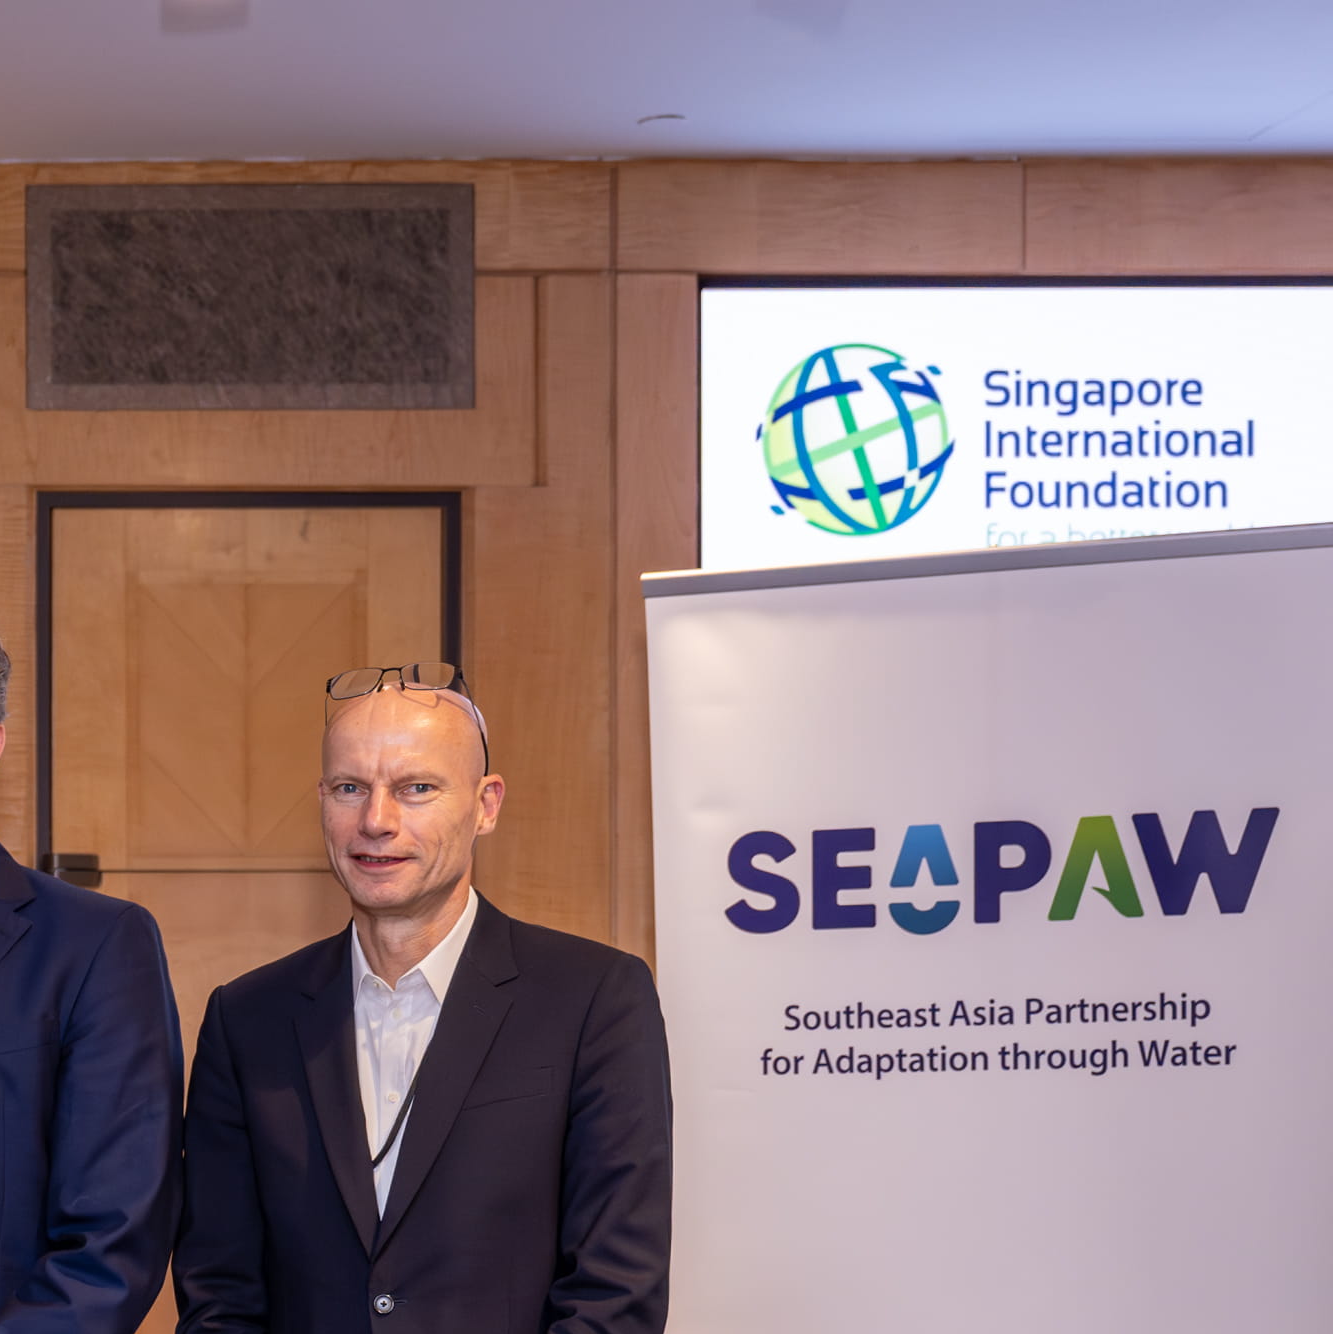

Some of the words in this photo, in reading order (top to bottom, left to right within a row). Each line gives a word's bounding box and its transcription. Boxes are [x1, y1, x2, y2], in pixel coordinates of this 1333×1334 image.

[984, 370, 1203, 416] Singapore
[985, 420, 1255, 457] International
[985, 471, 1228, 508] Foundation
[725, 807, 1280, 934] SEAPAW
[784, 1002, 941, 1031] Southeast
[949, 998, 1014, 1027] Asia
[1025, 992, 1211, 1028] Partnership
[760, 1047, 805, 1075] for
[813, 1044, 989, 1080] Adaptation
[998, 1040, 1129, 1076] through
[1138, 1040, 1238, 1068] Water
